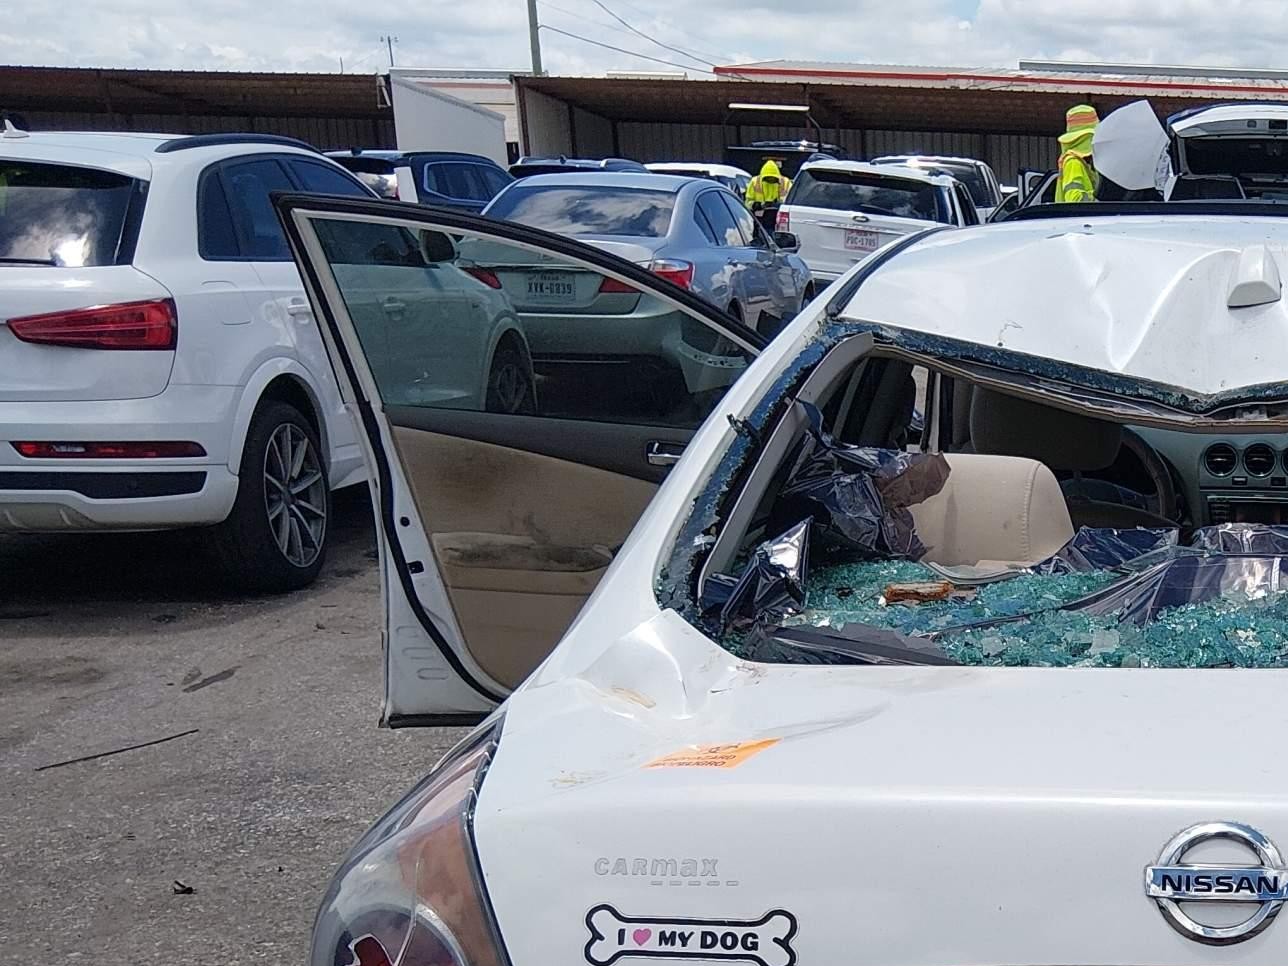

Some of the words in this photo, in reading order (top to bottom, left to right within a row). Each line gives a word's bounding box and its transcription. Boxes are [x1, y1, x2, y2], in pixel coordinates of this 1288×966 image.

[1161, 874, 1278, 894] NISSAN
[618, 928, 626, 946] I
[658, 930, 695, 948] MY
[700, 931, 759, 951] DOG
